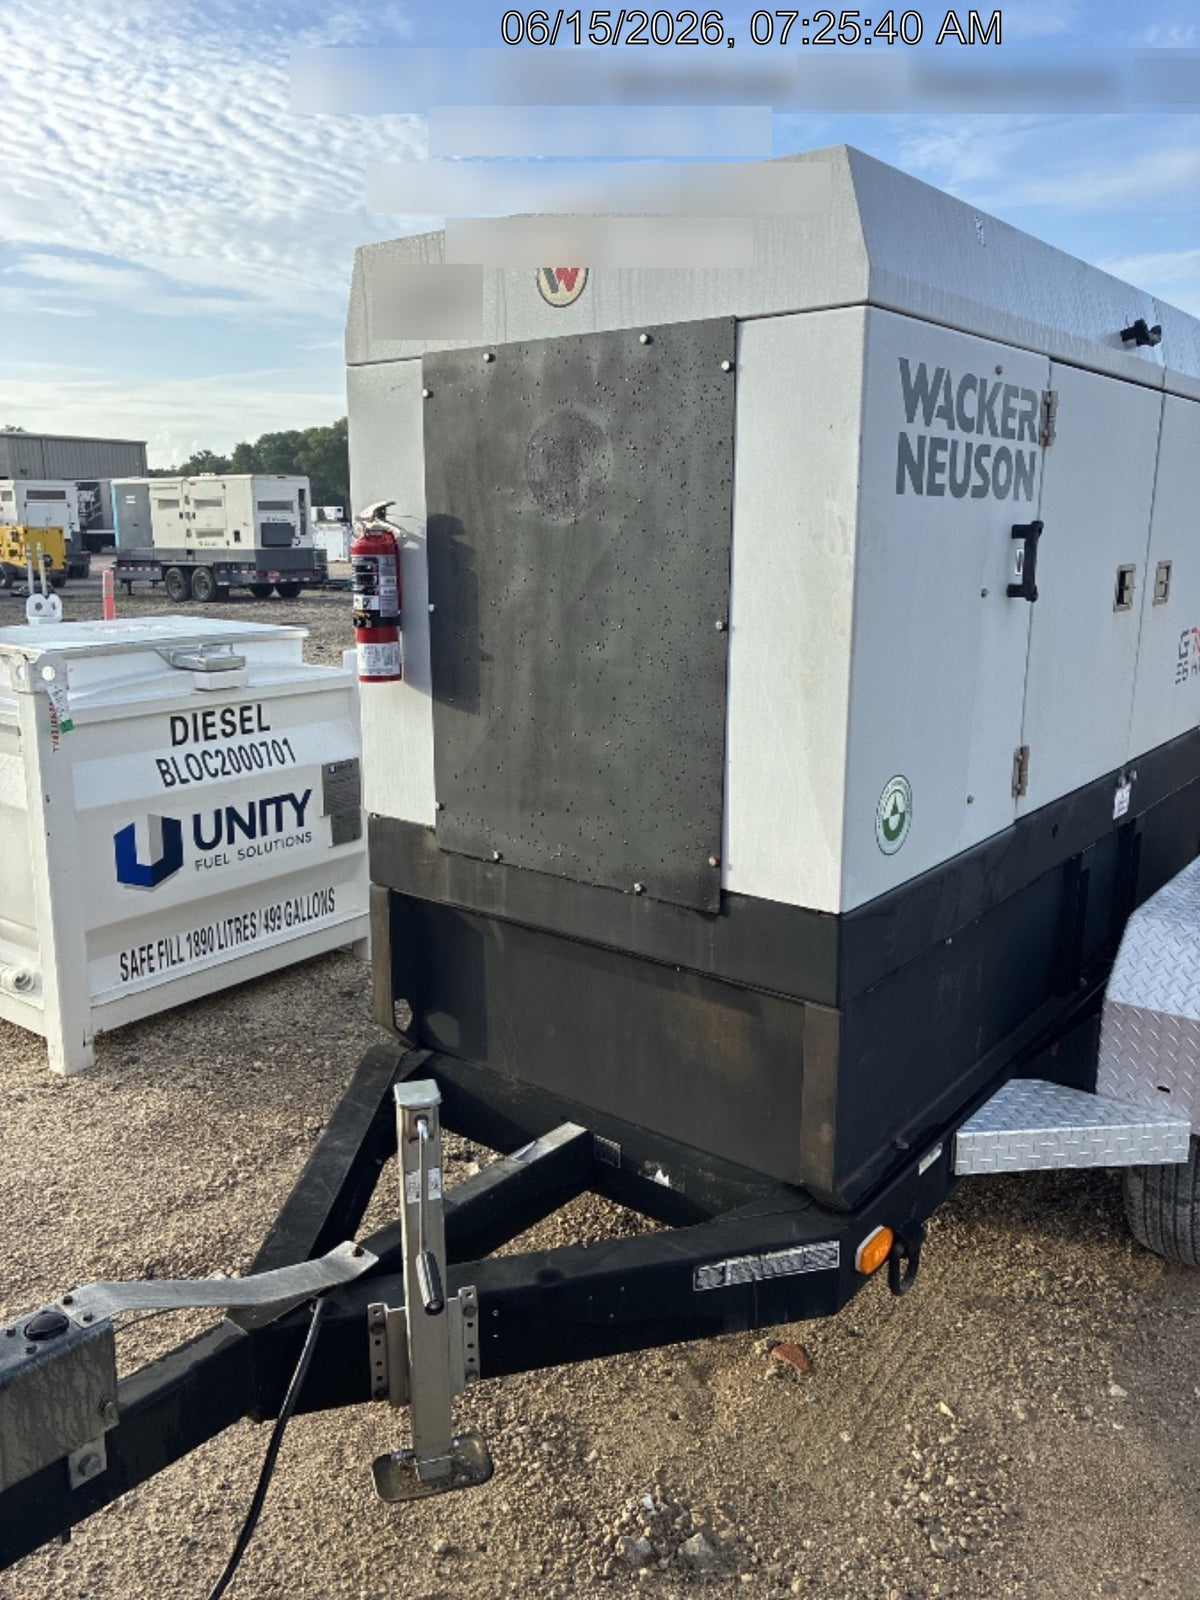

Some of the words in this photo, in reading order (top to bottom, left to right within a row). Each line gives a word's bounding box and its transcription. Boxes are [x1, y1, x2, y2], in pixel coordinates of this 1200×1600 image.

[898, 357, 1039, 443] WACKER
[896, 431, 1037, 501] NEUSON
[170, 703, 271, 747] DIESEL
[155, 737, 296, 788] BLOC2000701
[192, 788, 313, 851] UNITY
[194, 853, 230, 871] FUEL
[237, 831, 313, 861] SOLUTIONS
[119, 943, 155, 982] SAFE
[157, 934, 185, 970] FILL
[186, 925, 215, 960] 1890
[216, 911, 257, 951] LITRES
[284, 886, 336, 928] GALLONS
